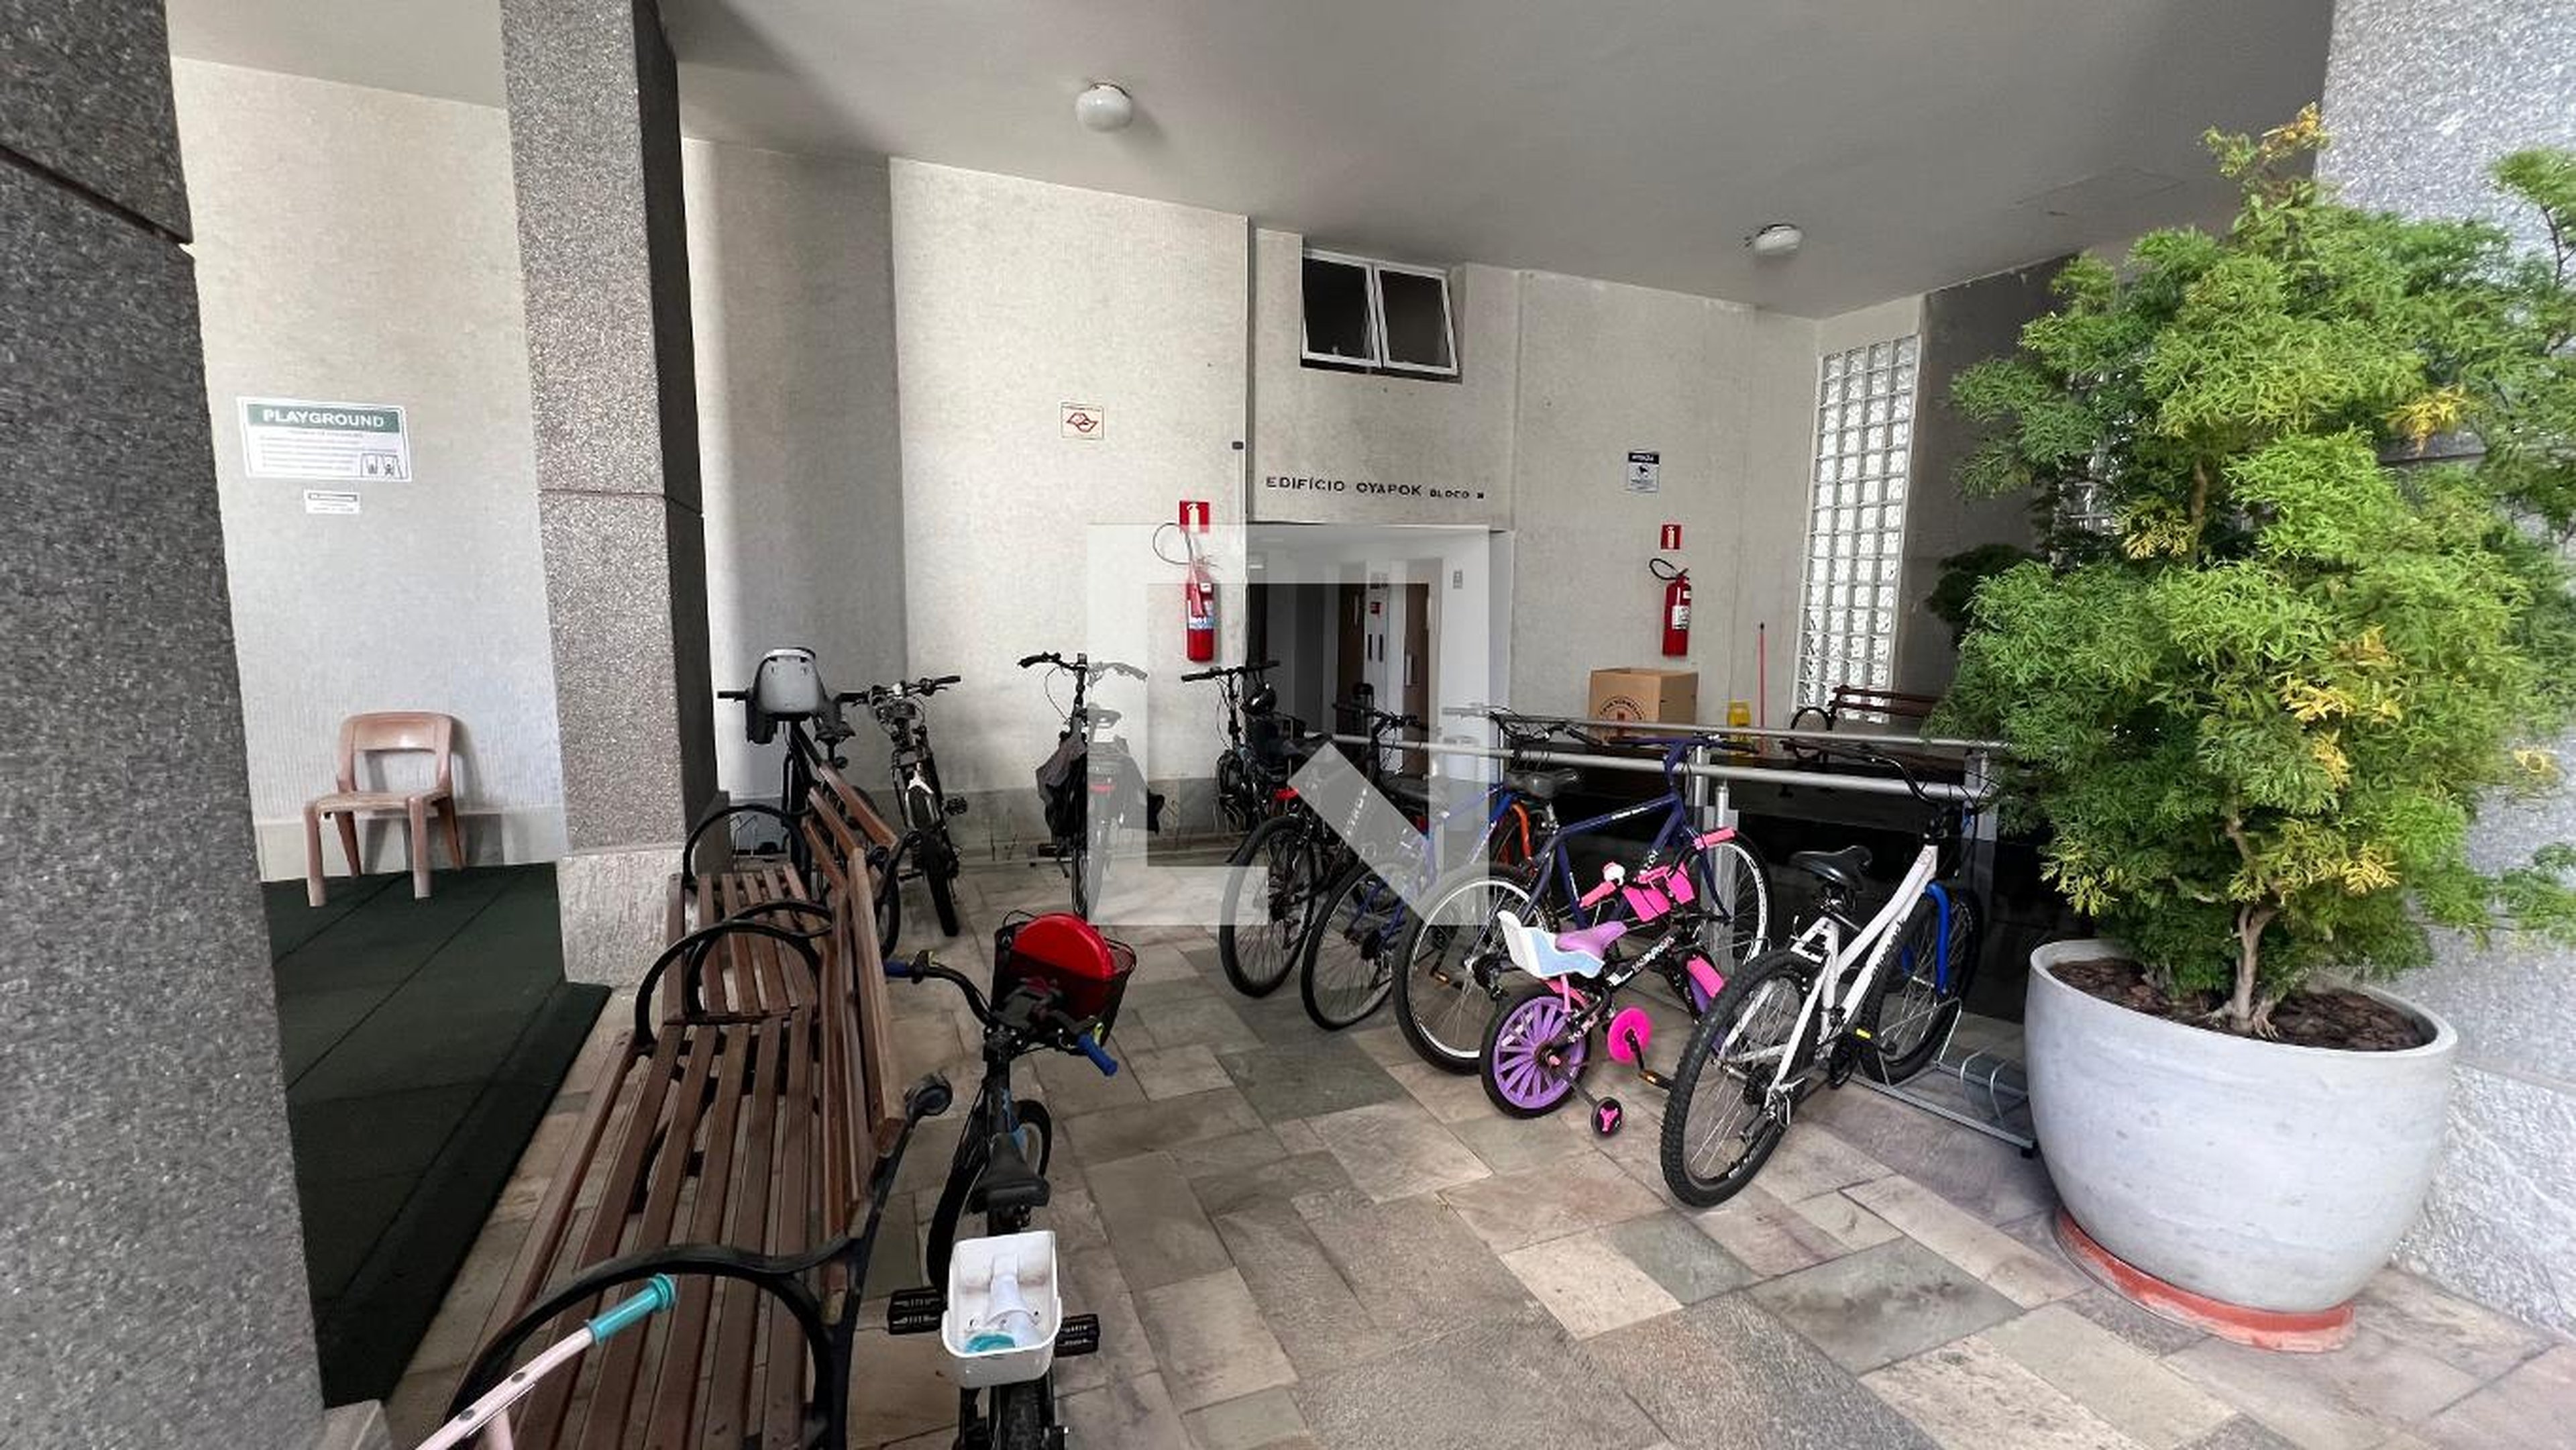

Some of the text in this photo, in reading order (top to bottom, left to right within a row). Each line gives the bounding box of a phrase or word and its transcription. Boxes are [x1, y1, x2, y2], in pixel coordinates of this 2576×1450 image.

[263, 409, 384, 427] PLAYGROUND
[1266, 477, 1345, 492] EDIFÍCIO
[1356, 482, 1422, 497] OYAPOK
